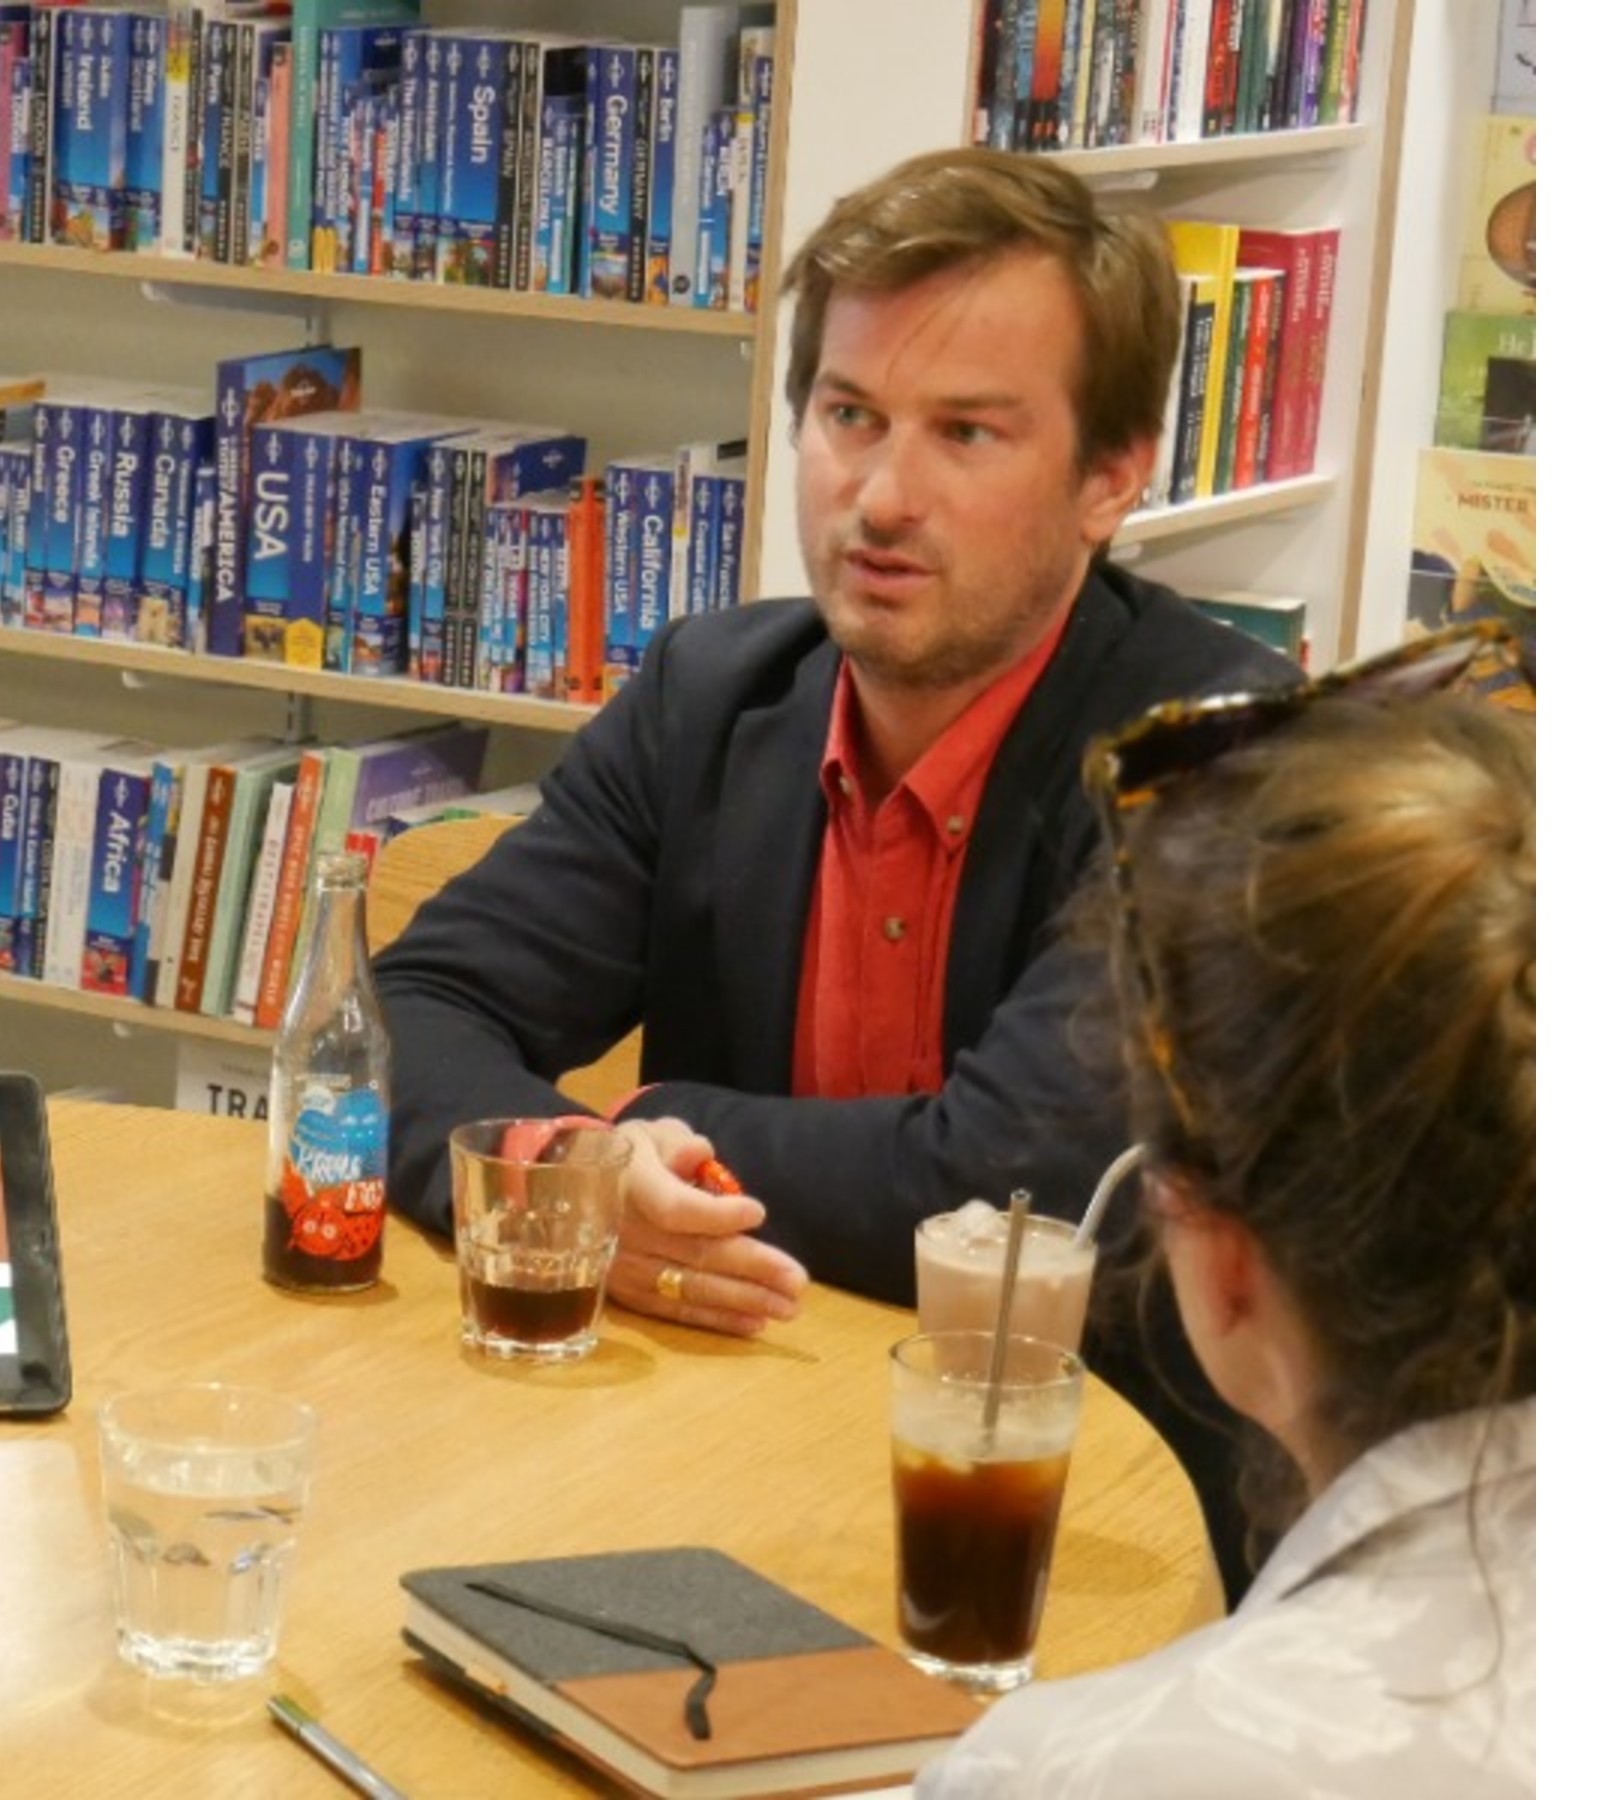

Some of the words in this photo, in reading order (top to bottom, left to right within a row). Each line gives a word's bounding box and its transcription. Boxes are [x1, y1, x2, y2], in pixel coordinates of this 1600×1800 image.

[77, 55, 94, 131] Ireland
[469, 85, 496, 165] Spain
[658, 97, 673, 143] Berlin
[599, 94, 629, 215] Germany
[633, 139, 647, 220] GERMANY
[53, 445, 77, 524] Greece
[87, 450, 103, 502] Greek
[112, 452, 138, 538] Russia
[151, 455, 176, 550] Canada
[85, 507, 102, 569] Islands
[216, 492, 238, 603] AMERICA
[253, 471, 290, 560] USA
[367, 483, 386, 553] Eastern
[614, 510, 630, 577] Western
[363, 557, 380, 595] USA
[613, 582, 628, 614] USA
[641, 515, 663, 630] California
[0, 794, 18, 841] Cuba
[102, 811, 131, 893] Africa
[207, 1082, 268, 1122] TRA
